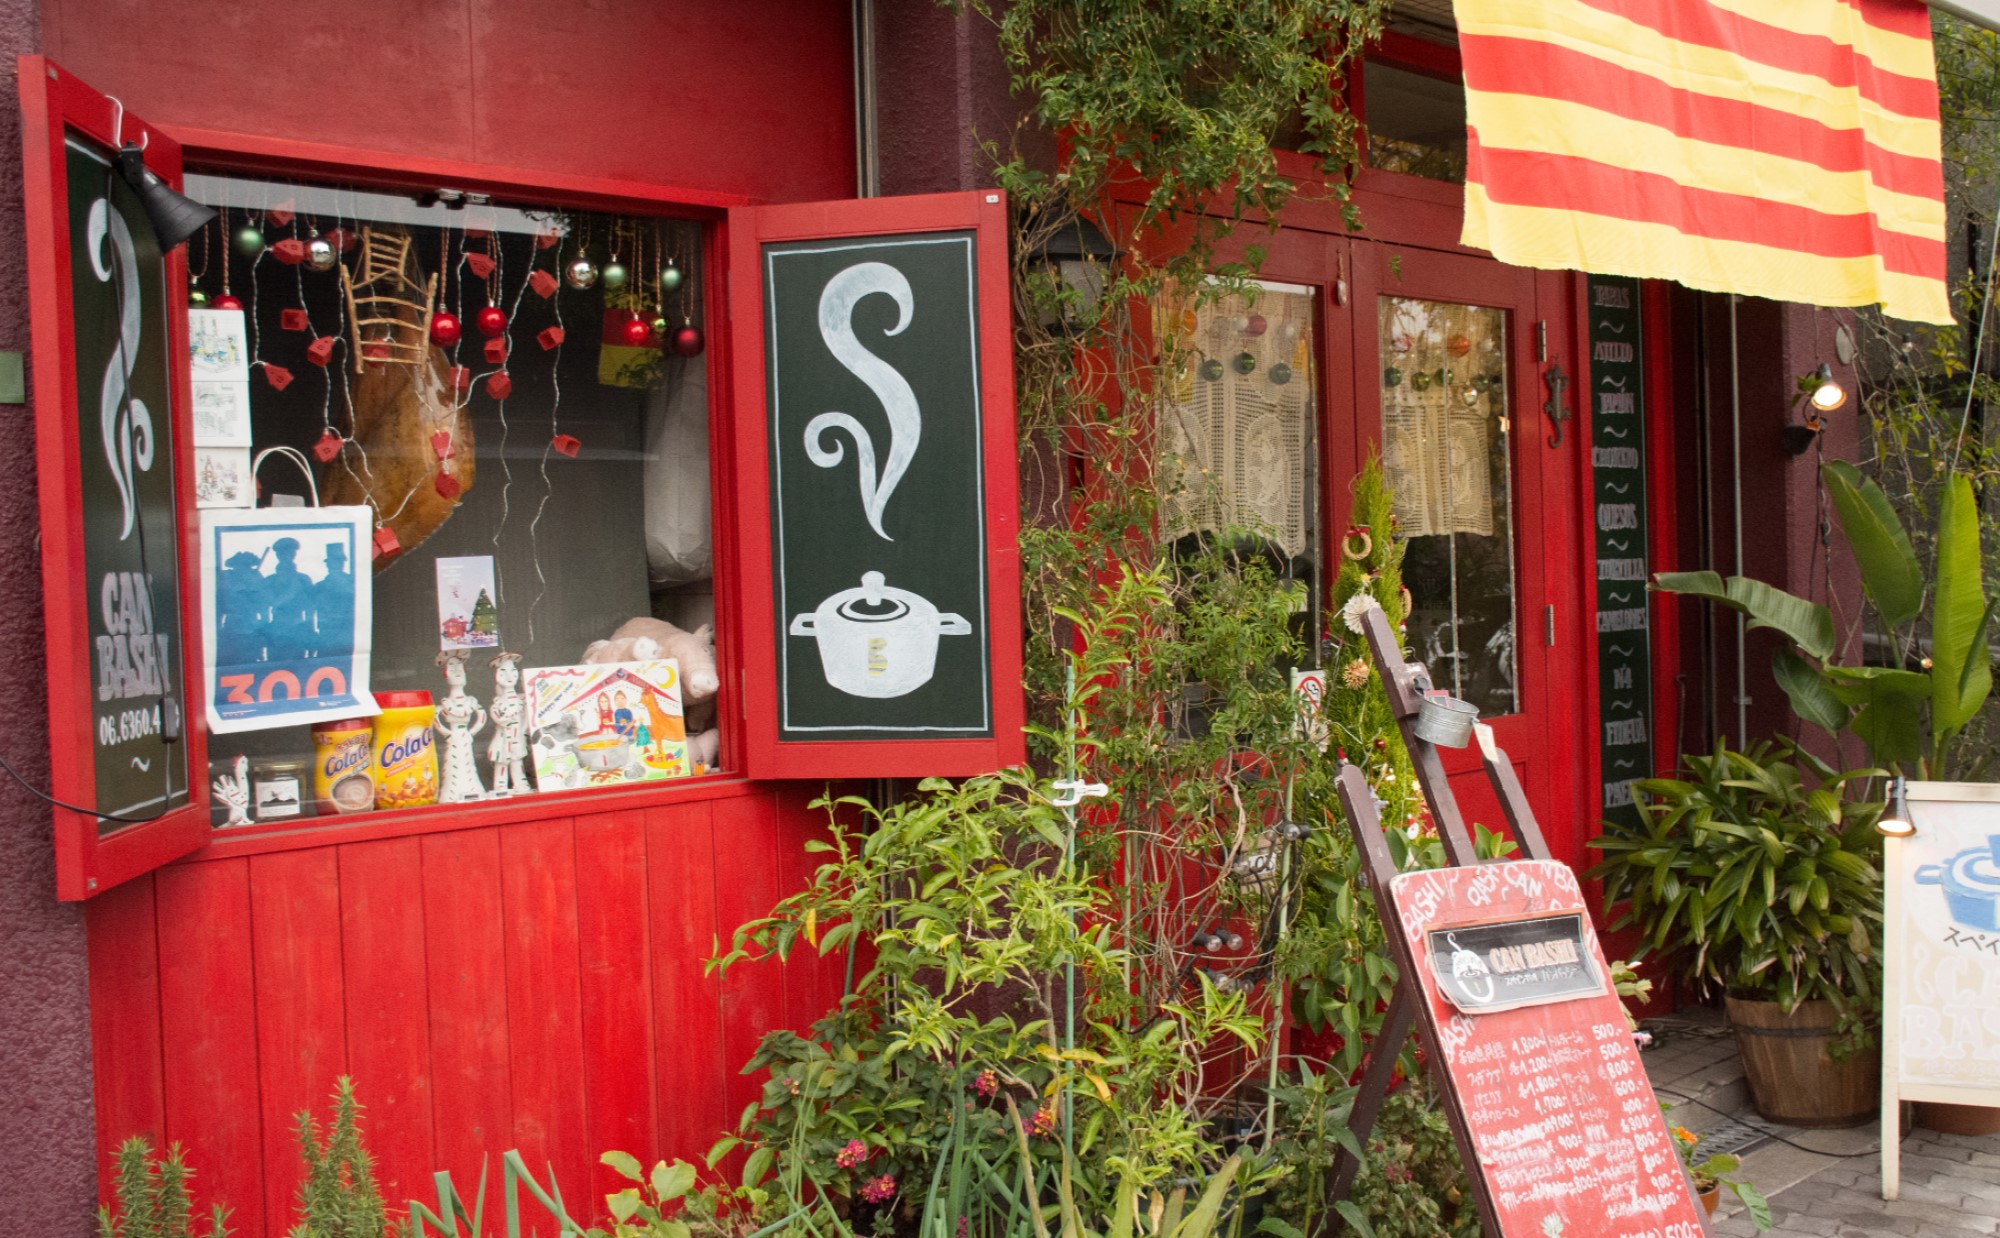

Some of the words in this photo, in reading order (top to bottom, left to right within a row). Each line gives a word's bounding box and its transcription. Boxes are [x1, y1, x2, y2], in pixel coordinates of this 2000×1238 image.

[102, 571, 153, 635] CAN
[1489, 945, 1527, 975] CAN
[1521, 938, 1580, 969] BASHI
